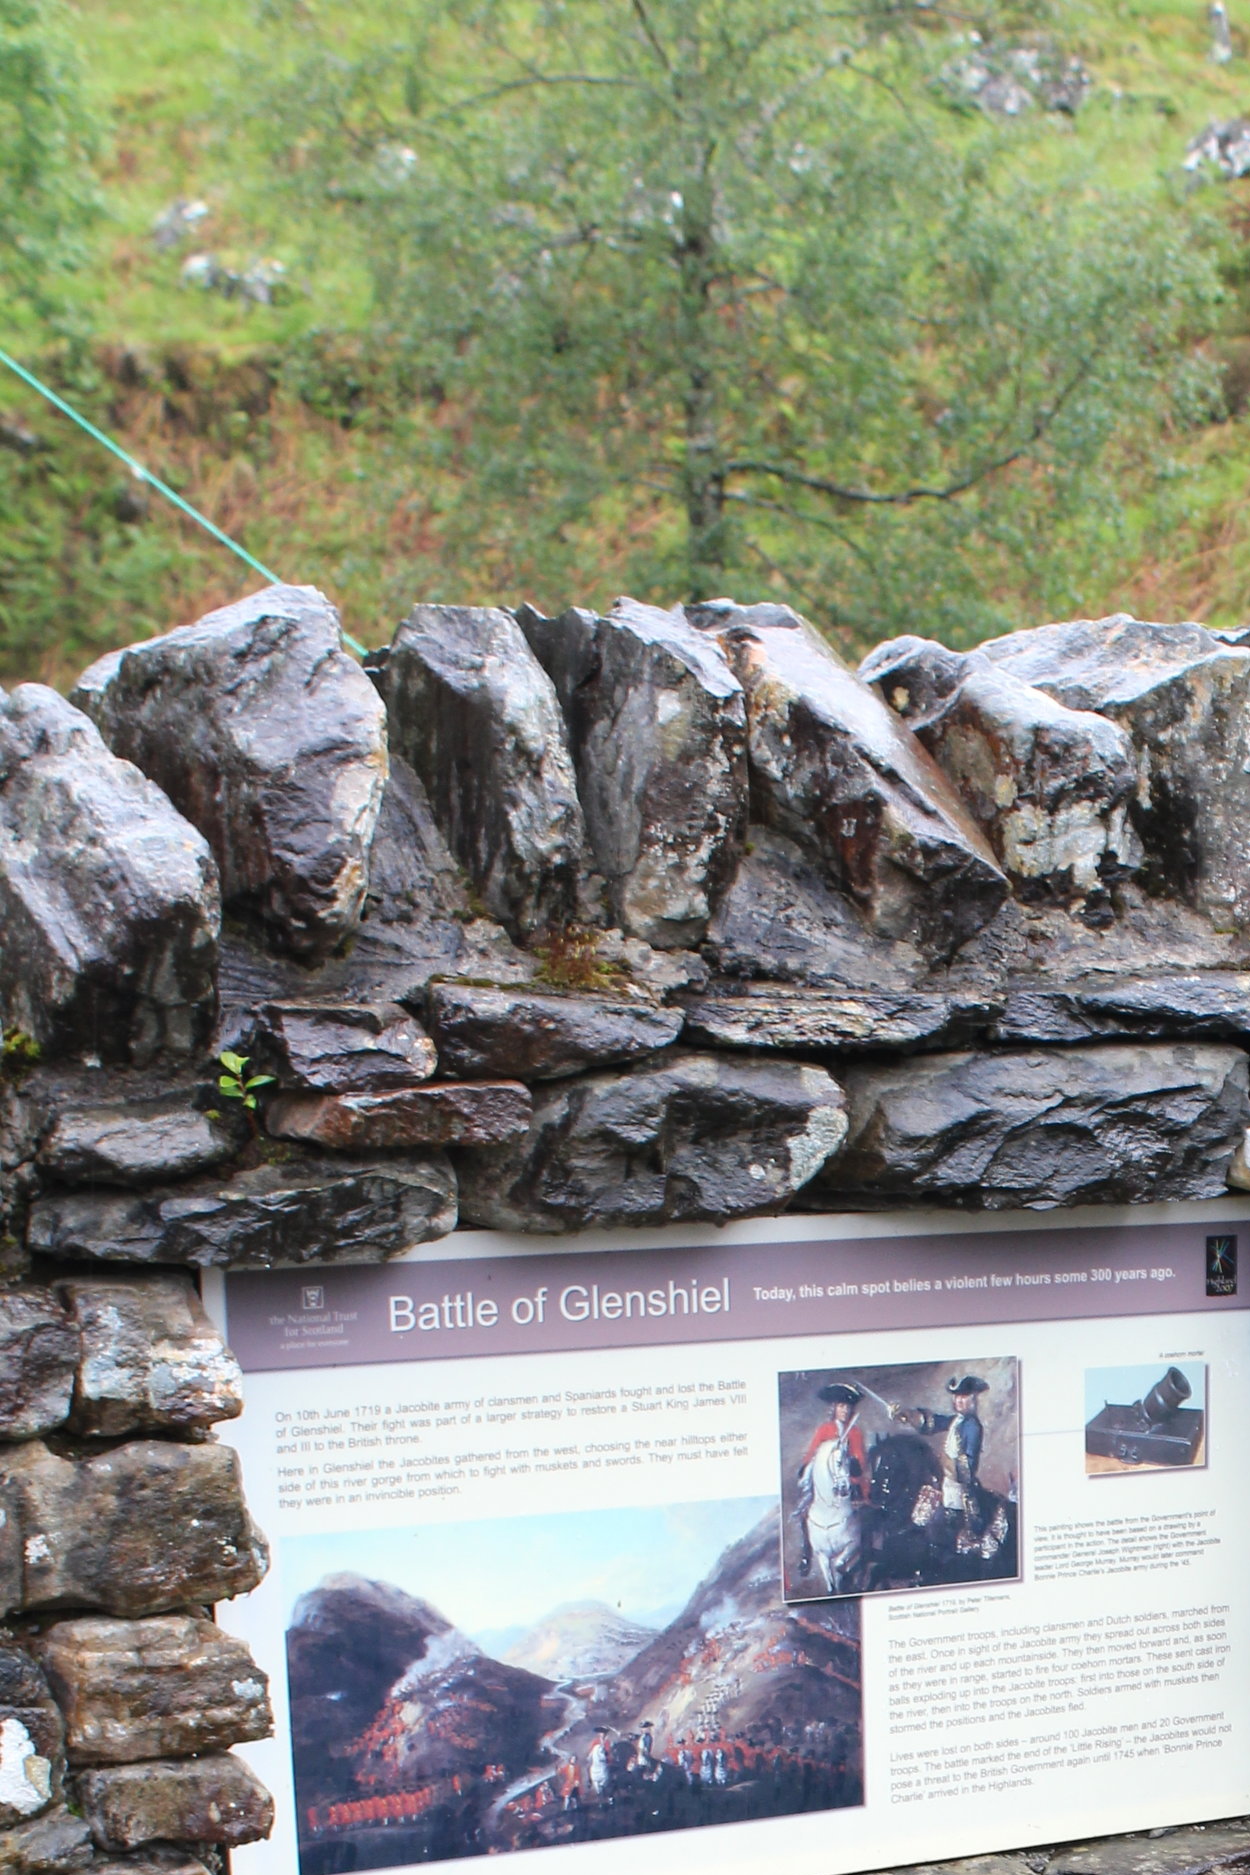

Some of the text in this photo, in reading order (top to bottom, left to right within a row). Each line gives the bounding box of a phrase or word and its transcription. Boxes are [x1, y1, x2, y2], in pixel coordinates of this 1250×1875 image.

[798, 1284, 823, 1297] this
[826, 1282, 858, 1296] calm
[861, 1281, 890, 1296] spot
[892, 1278, 931, 1292] belies
[933, 1280, 942, 1290] a
[945, 1275, 987, 1289] violent
[989, 1274, 1012, 1287] few
[1014, 1272, 1051, 1285] hours
[1053, 1272, 1087, 1283] some
[1090, 1268, 1112, 1281] 300
[1113, 1269, 1147, 1283] years
[288, 1312, 331, 1324] National
[333, 1311, 358, 1321] Trust
[389, 1277, 731, 1332] Battle of Glenshiel
[302, 1323, 344, 1336] Scotland
[274, 1379, 746, 1422] On 10th June 1719 a Jacobite army of clansmen and Spaniards fought and lost the Battle
[275, 1427, 286, 1438] of
[350, 1420, 377, 1432] Their
[381, 1418, 405, 1432] fight
[409, 1419, 431, 1428] was
[434, 1415, 456, 1428] part
[460, 1413, 471, 1424] of
[474, 1415, 482, 1423] a
[486, 1410, 516, 1424] larger
[520, 1408, 562, 1420] strategy
[566, 1406, 577, 1416] to
[580, 1404, 617, 1415] restore
[620, 1404, 628, 1412] a
[631, 1399, 662, 1412] Stuart
[665, 1397, 689, 1410] King
[693, 1395, 726, 1407] James
[729, 1393, 747, 1404] VIII
[276, 1442, 297, 1453] and
[300, 1441, 311, 1451] III
[313, 1441, 325, 1450] to
[327, 1438, 345, 1449] the
[347, 1435, 382, 1448] British
[276, 1466, 304, 1477] Here
[307, 1464, 319, 1474] in
[322, 1459, 374, 1473] Glenshiel
[377, 1458, 395, 1469] the
[399, 1454, 450, 1467] Jacobites
[453, 1449, 501, 1465] gathered
[504, 1448, 529, 1459] from
[532, 1446, 549, 1457] the
[584, 1440, 631, 1453] choosing
[634, 1438, 650, 1449] the
[654, 1438, 676, 1447] near
[680, 1433, 716, 1446] hilltops
[719, 1431, 747, 1442] either
[277, 1481, 301, 1492] side
[304, 1480, 316, 1490] of
[319, 1478, 339, 1489] this
[342, 1476, 367, 1487] river
[370, 1475, 402, 1487] gorge
[405, 1471, 431, 1482] from
[434, 1468, 466, 1480] which
[468, 1467, 480, 1477] to
[482, 1464, 506, 1478] fight
[509, 1462, 531, 1474] with
[534, 1459, 578, 1472] muskets
[581, 1457, 602, 1468] and
[649, 1451, 673, 1464] They
[676, 1450, 702, 1460] must
[704, 1447, 730, 1458] have
[732, 1445, 748, 1456] felt
[278, 1497, 302, 1509] they
[305, 1496, 332, 1506] were
[334, 1493, 345, 1503] in
[347, 1493, 362, 1502] an
[364, 1487, 415, 1501] invincible
[888, 1639, 906, 1649] The
[908, 1632, 965, 1647] Government
[1000, 1624, 1040, 1637] including
[1042, 1619, 1085, 1632] clansmen
[1086, 1616, 1104, 1627] and
[1105, 1613, 1131, 1625] Dutch
[1171, 1605, 1209, 1618] marched
[1210, 1603, 1230, 1614] from
[889, 1710, 1224, 1762] Lives were lost on both sides around 100 Jacobite men and 20 Government
[890, 1790, 924, 1804] Charlie'
[927, 1785, 959, 1798] arrived
[960, 1784, 969, 1794] in
[971, 1782, 986, 1792] the
